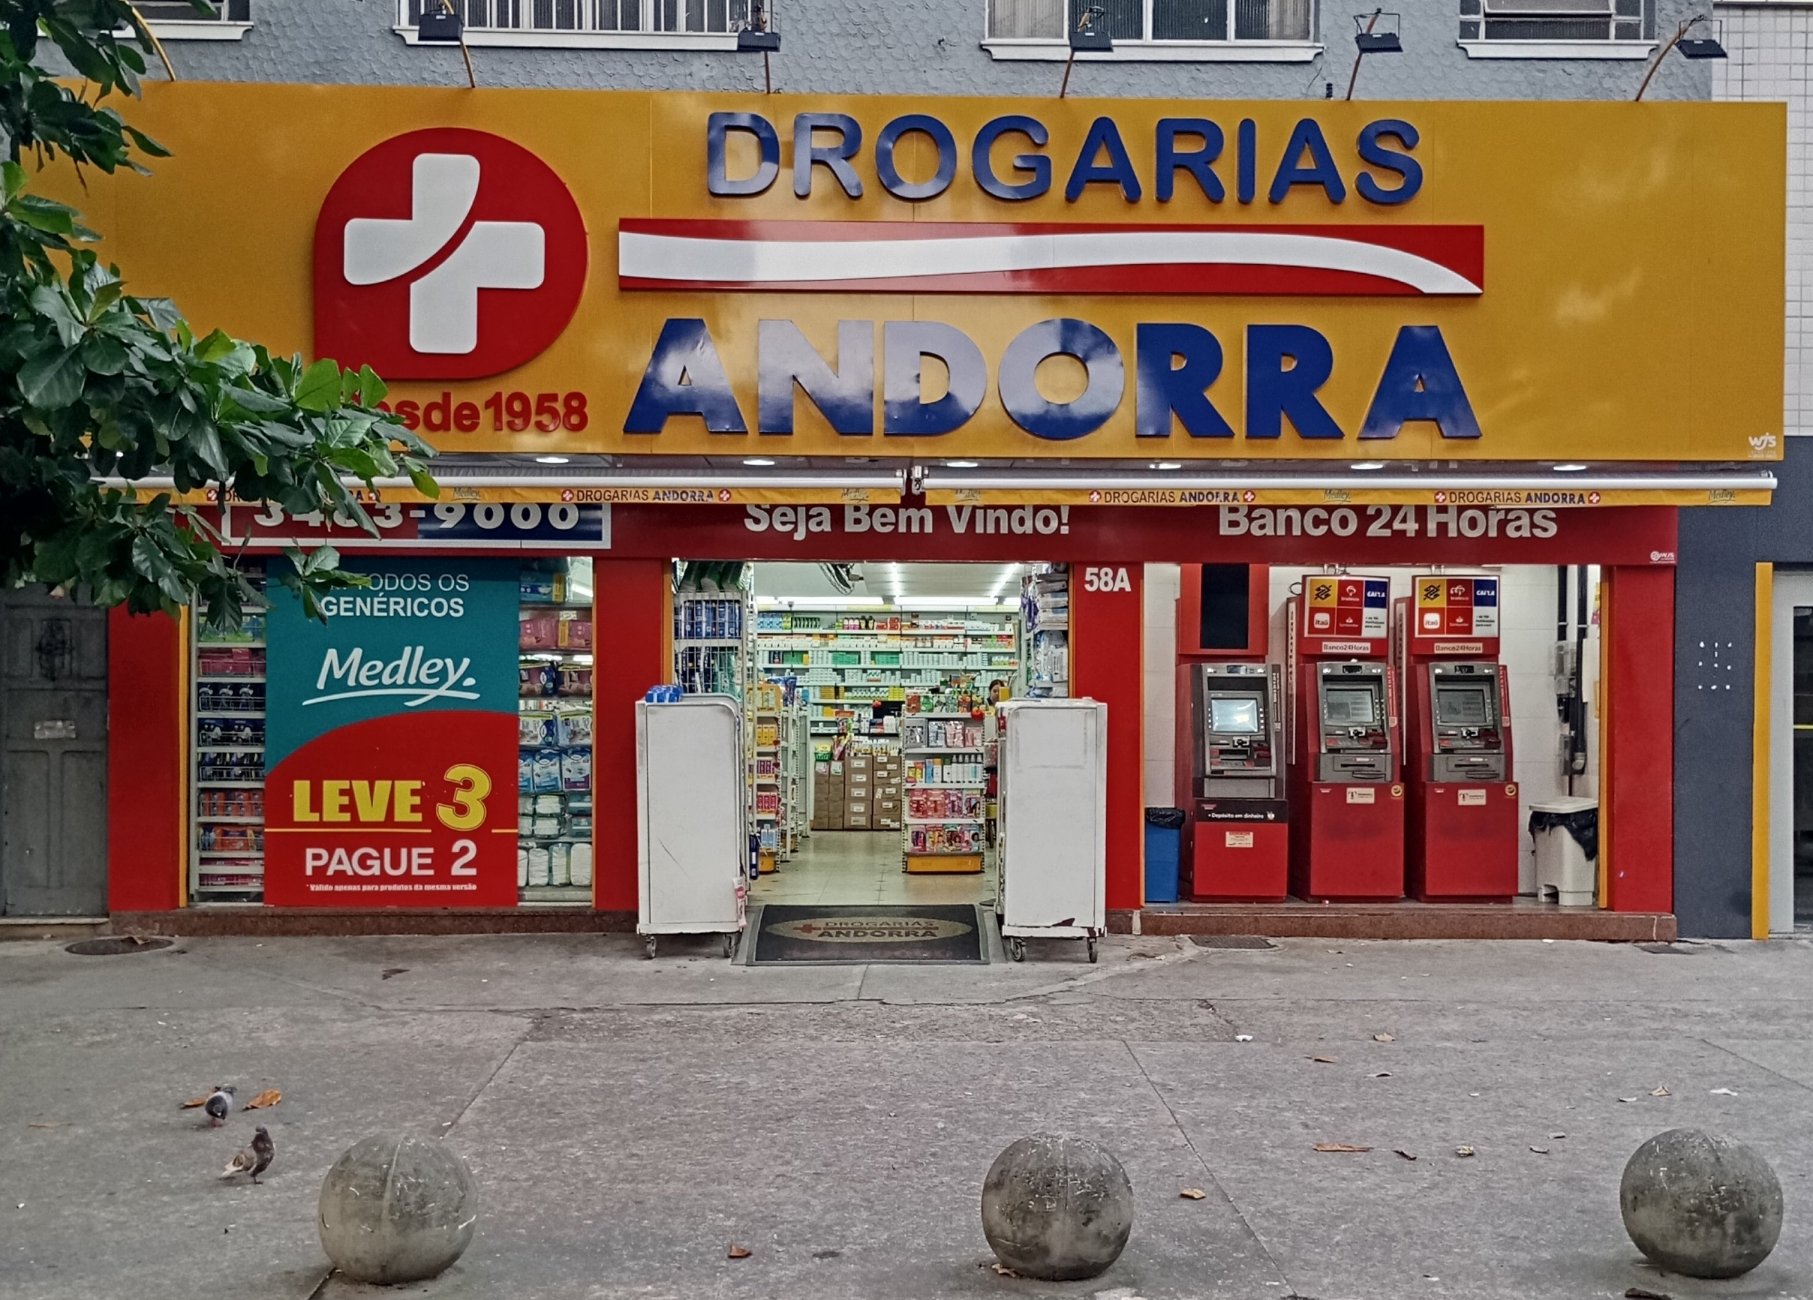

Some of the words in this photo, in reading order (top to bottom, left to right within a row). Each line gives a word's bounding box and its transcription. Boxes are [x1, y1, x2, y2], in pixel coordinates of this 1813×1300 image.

[707, 110, 1425, 205] DROGARIAS
[622, 316, 1483, 441] ANDORRA
[484, 391, 589, 432] 1958
[576, 489, 649, 502] DROGARIAS
[653, 490, 714, 502] ANDORRA
[1104, 490, 1175, 503] DROGARIAS
[1179, 491, 1240, 503] ANDORRA
[1449, 491, 1522, 504] DROGARIAS
[1525, 492, 1586, 505] ANDORRA
[744, 504, 832, 541] Seja
[844, 503, 934, 534] Bem
[946, 504, 1070, 535] Vindo!
[1219, 504, 1358, 537] Banco
[1366, 505, 1419, 537] 24
[1427, 505, 1558, 538] Horas
[438, 573, 470, 592] OS
[1084, 567, 1132, 592] 58A
[320, 592, 465, 618] GENÉRICOS
[292, 780, 423, 823] LEVE
[436, 763, 493, 831] 3
[304, 847, 435, 877] PAGUE
[450, 839, 478, 876] 2
[817, 930, 938, 938] ANDORRA
